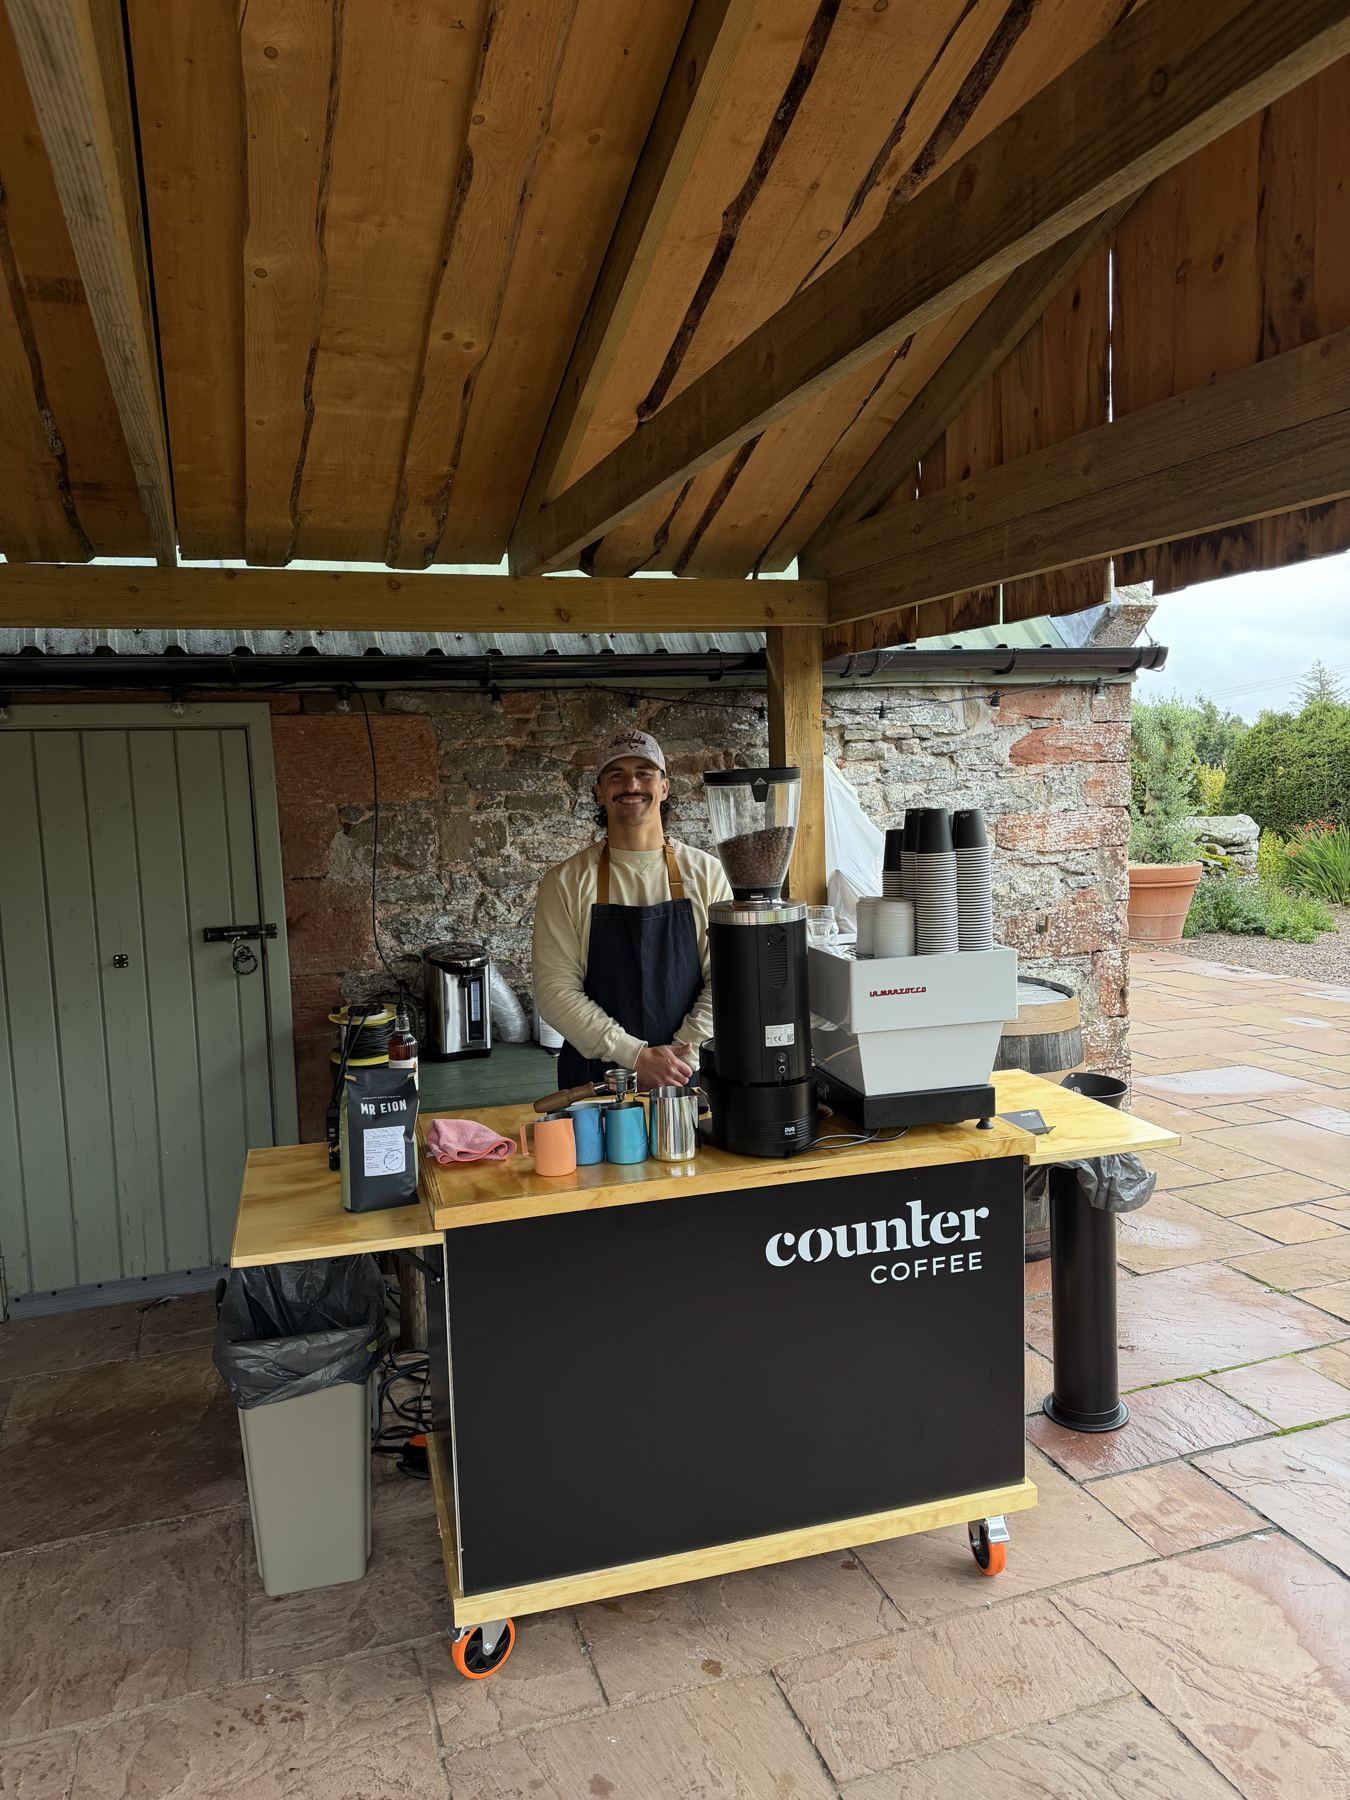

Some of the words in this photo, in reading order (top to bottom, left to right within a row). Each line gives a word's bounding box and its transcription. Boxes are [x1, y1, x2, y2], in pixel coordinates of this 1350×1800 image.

[360, 1102, 376, 1115] MR
[380, 1099, 407, 1113] EION
[765, 1199, 990, 1267] counter
[870, 1251, 983, 1284] COFFEE
